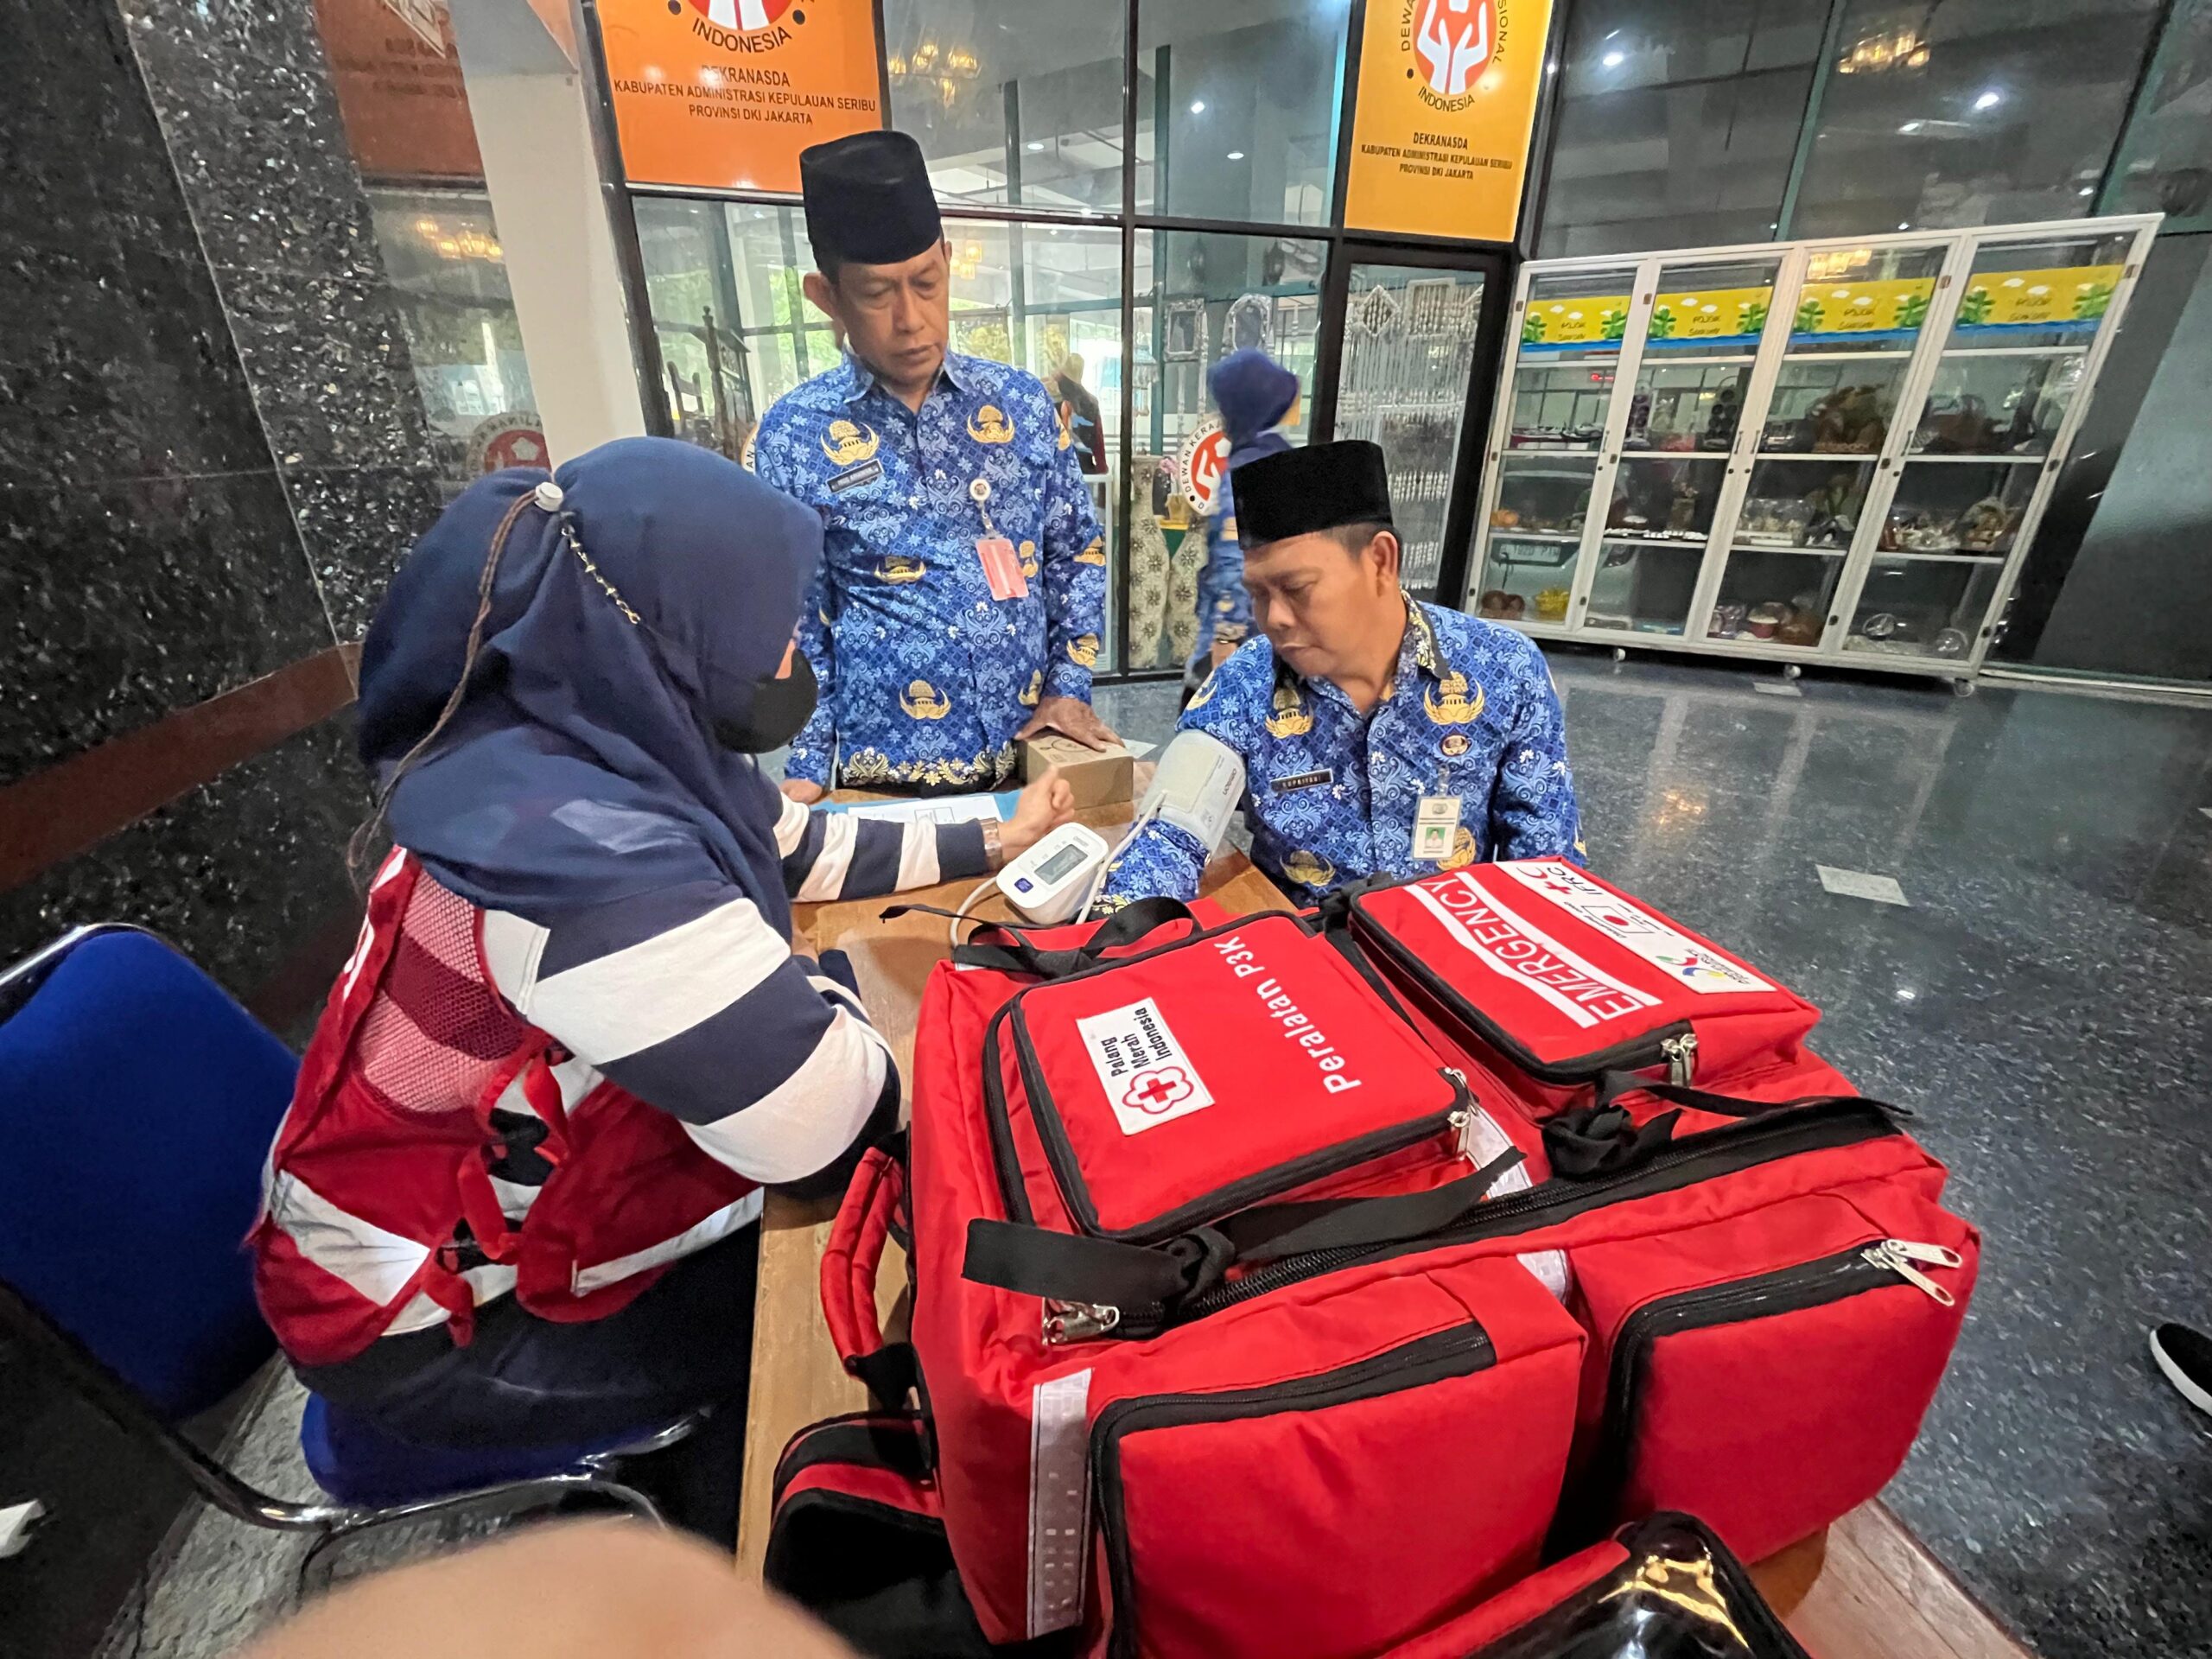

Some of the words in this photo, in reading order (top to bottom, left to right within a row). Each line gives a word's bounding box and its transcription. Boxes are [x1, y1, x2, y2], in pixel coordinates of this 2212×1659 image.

[692, 17, 792, 54] INDONESIA
[613, 79, 683, 98] KABUPATEN
[687, 86, 766, 104] ADMINISTRASI
[768, 92, 835, 109] KEPULAUAN
[837, 98, 876, 112] SERIBU
[1418, 86, 1475, 112] INDONESIA
[689, 105, 741, 120] PROVINSI
[743, 108, 762, 122] DKI
[765, 111, 813, 125] JAKARTA
[1361, 143, 1401, 157] KABUPATEN
[1450, 154, 1490, 168] KEPULAUAN
[1413, 131, 1468, 149] DEKRANASDA
[1445, 168, 1474, 180] JAKARTA
[1181, 450, 1192, 493] DEWAN
[1546, 866, 1605, 897] IFRC
[1213, 936, 1266, 978] P3K
[1420, 879, 1645, 1023] EMERGENCY
[1123, 1033, 1152, 1069] Merah
[1135, 1007, 1173, 1062] Indonesia
[1256, 978, 1362, 1094] Peralatan
[1101, 1037, 1128, 1077] Palang
